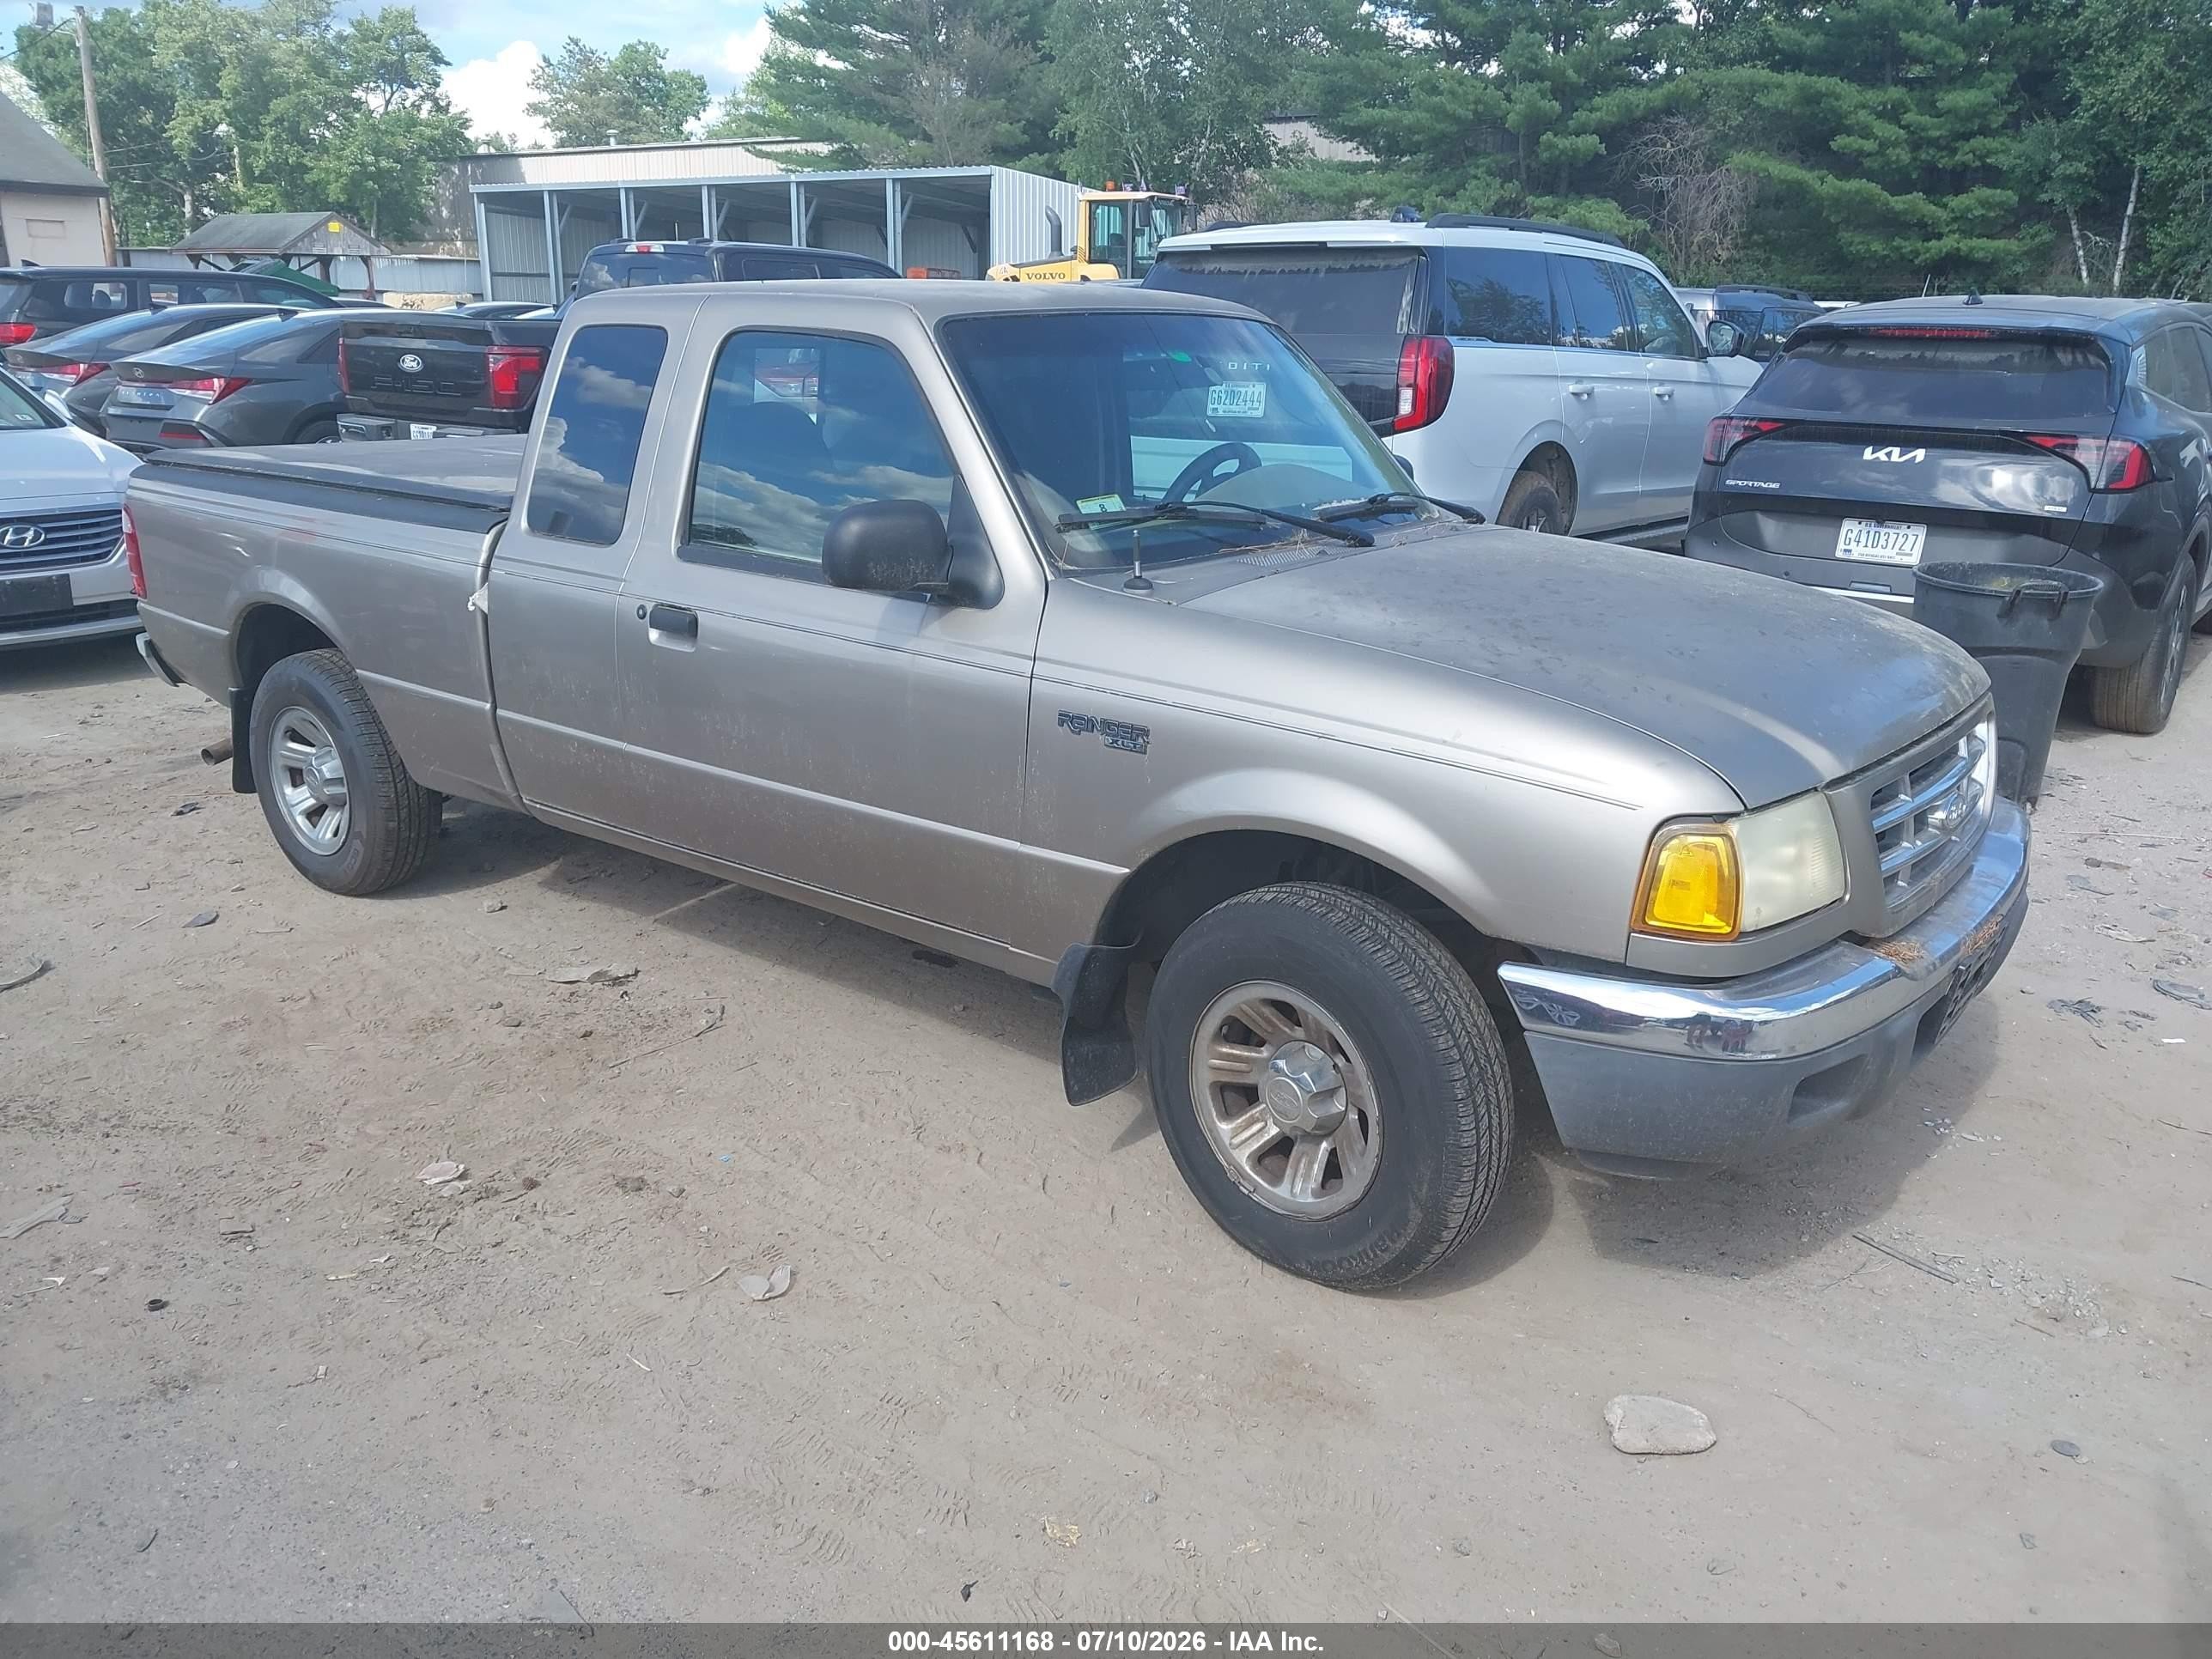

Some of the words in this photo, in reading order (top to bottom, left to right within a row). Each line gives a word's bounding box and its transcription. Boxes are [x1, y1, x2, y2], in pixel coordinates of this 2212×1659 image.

[1026, 272, 1066, 281] VOLVO
[1863, 446, 1926, 464] KIA
[1725, 479, 1781, 489] SPORTAGE
[1099, 503, 1108, 513] 8
[1843, 528, 1919, 552] G41D3727
[1057, 709, 1151, 744] RANGER
[1108, 738, 1141, 750] XLT
